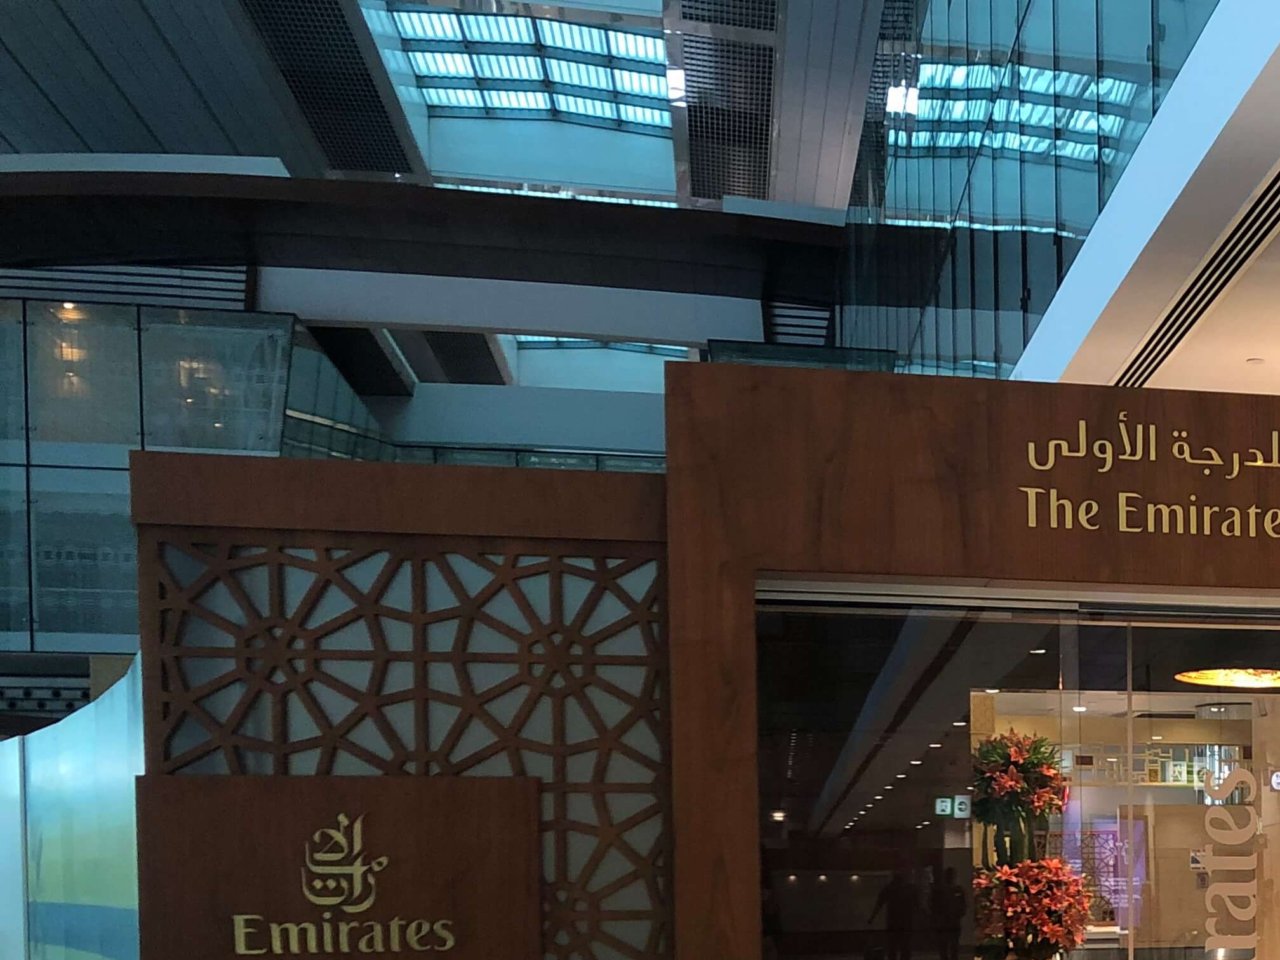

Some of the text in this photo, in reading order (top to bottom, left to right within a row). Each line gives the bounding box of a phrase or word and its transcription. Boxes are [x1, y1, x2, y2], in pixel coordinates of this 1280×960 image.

[1028, 411, 1156, 472] الأولى
[1018, 487, 1100, 530] The
[233, 911, 456, 955] Emirates
